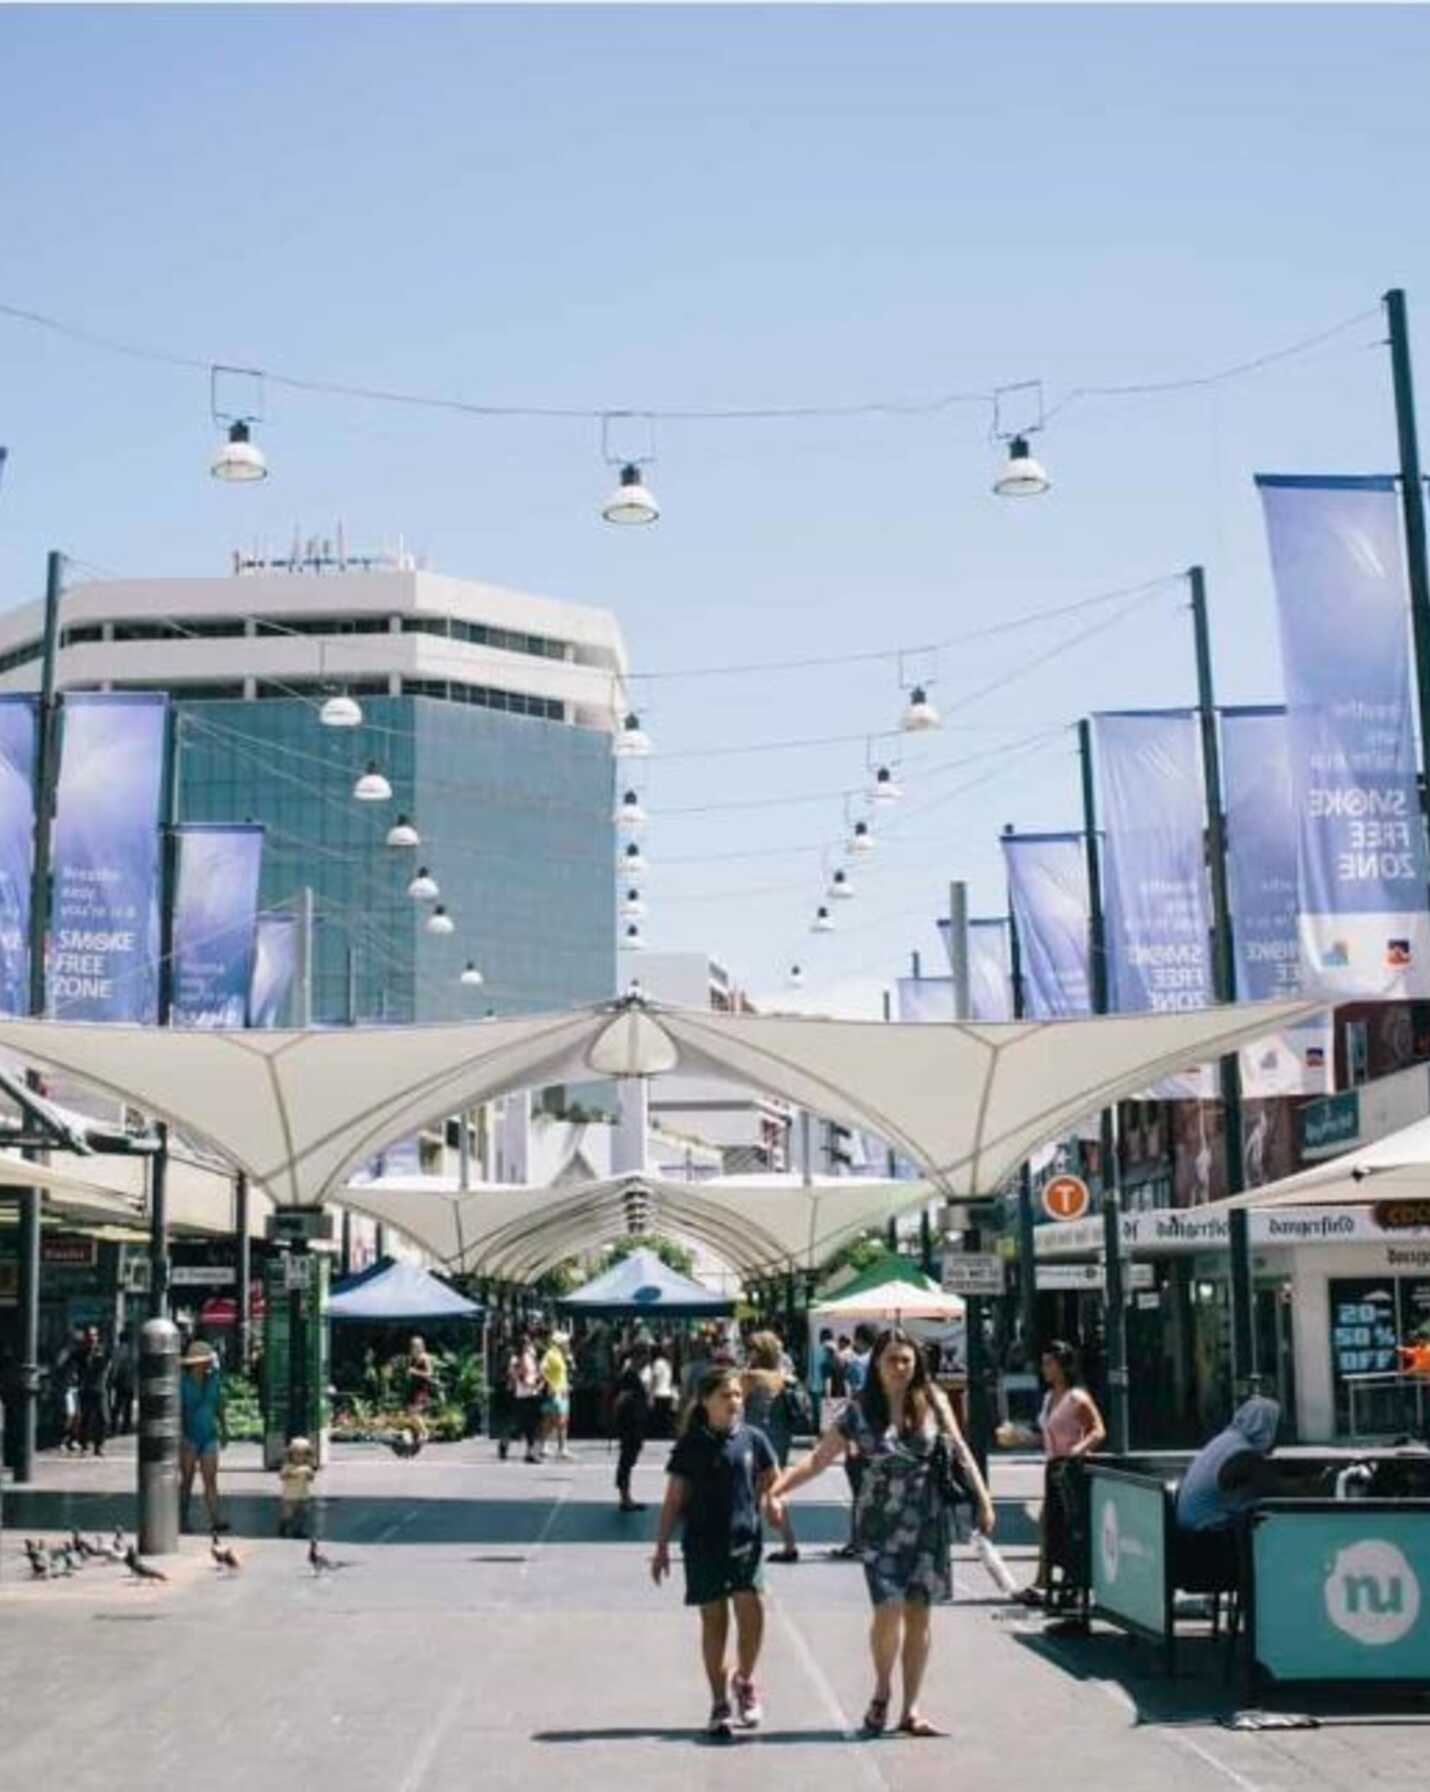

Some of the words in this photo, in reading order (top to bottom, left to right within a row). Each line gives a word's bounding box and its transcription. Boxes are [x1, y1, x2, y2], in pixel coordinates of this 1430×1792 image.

[59, 931, 136, 951] SMOKE
[57, 953, 105, 975] FREE
[50, 976, 113, 999] ZONE
[1054, 1184, 1076, 1212] T
[1341, 1350, 1394, 1370] OFF
[1344, 1574, 1404, 1613] nu
